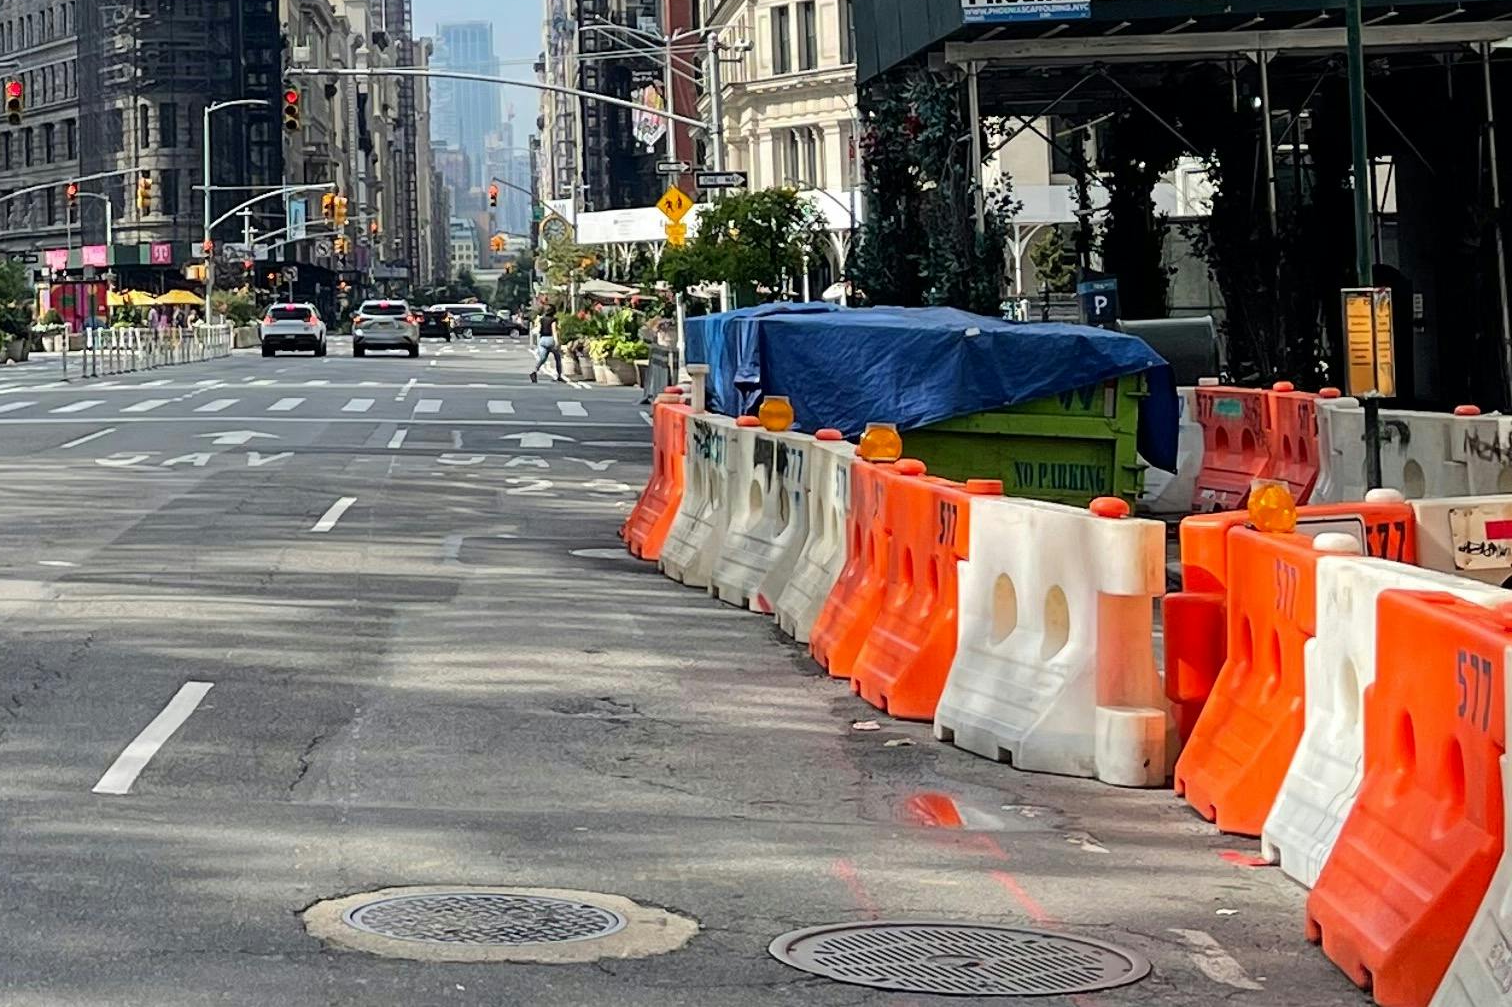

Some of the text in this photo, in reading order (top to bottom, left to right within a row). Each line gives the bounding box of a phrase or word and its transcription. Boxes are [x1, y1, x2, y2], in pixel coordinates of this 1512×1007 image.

[703, 175, 741, 185] ONE WAY
[1094, 295, 1108, 315] P
[1014, 460, 1107, 493] NO PARKING
[939, 500, 958, 546] 577
[1275, 558, 1297, 620] 577
[1456, 649, 1492, 733] 577
